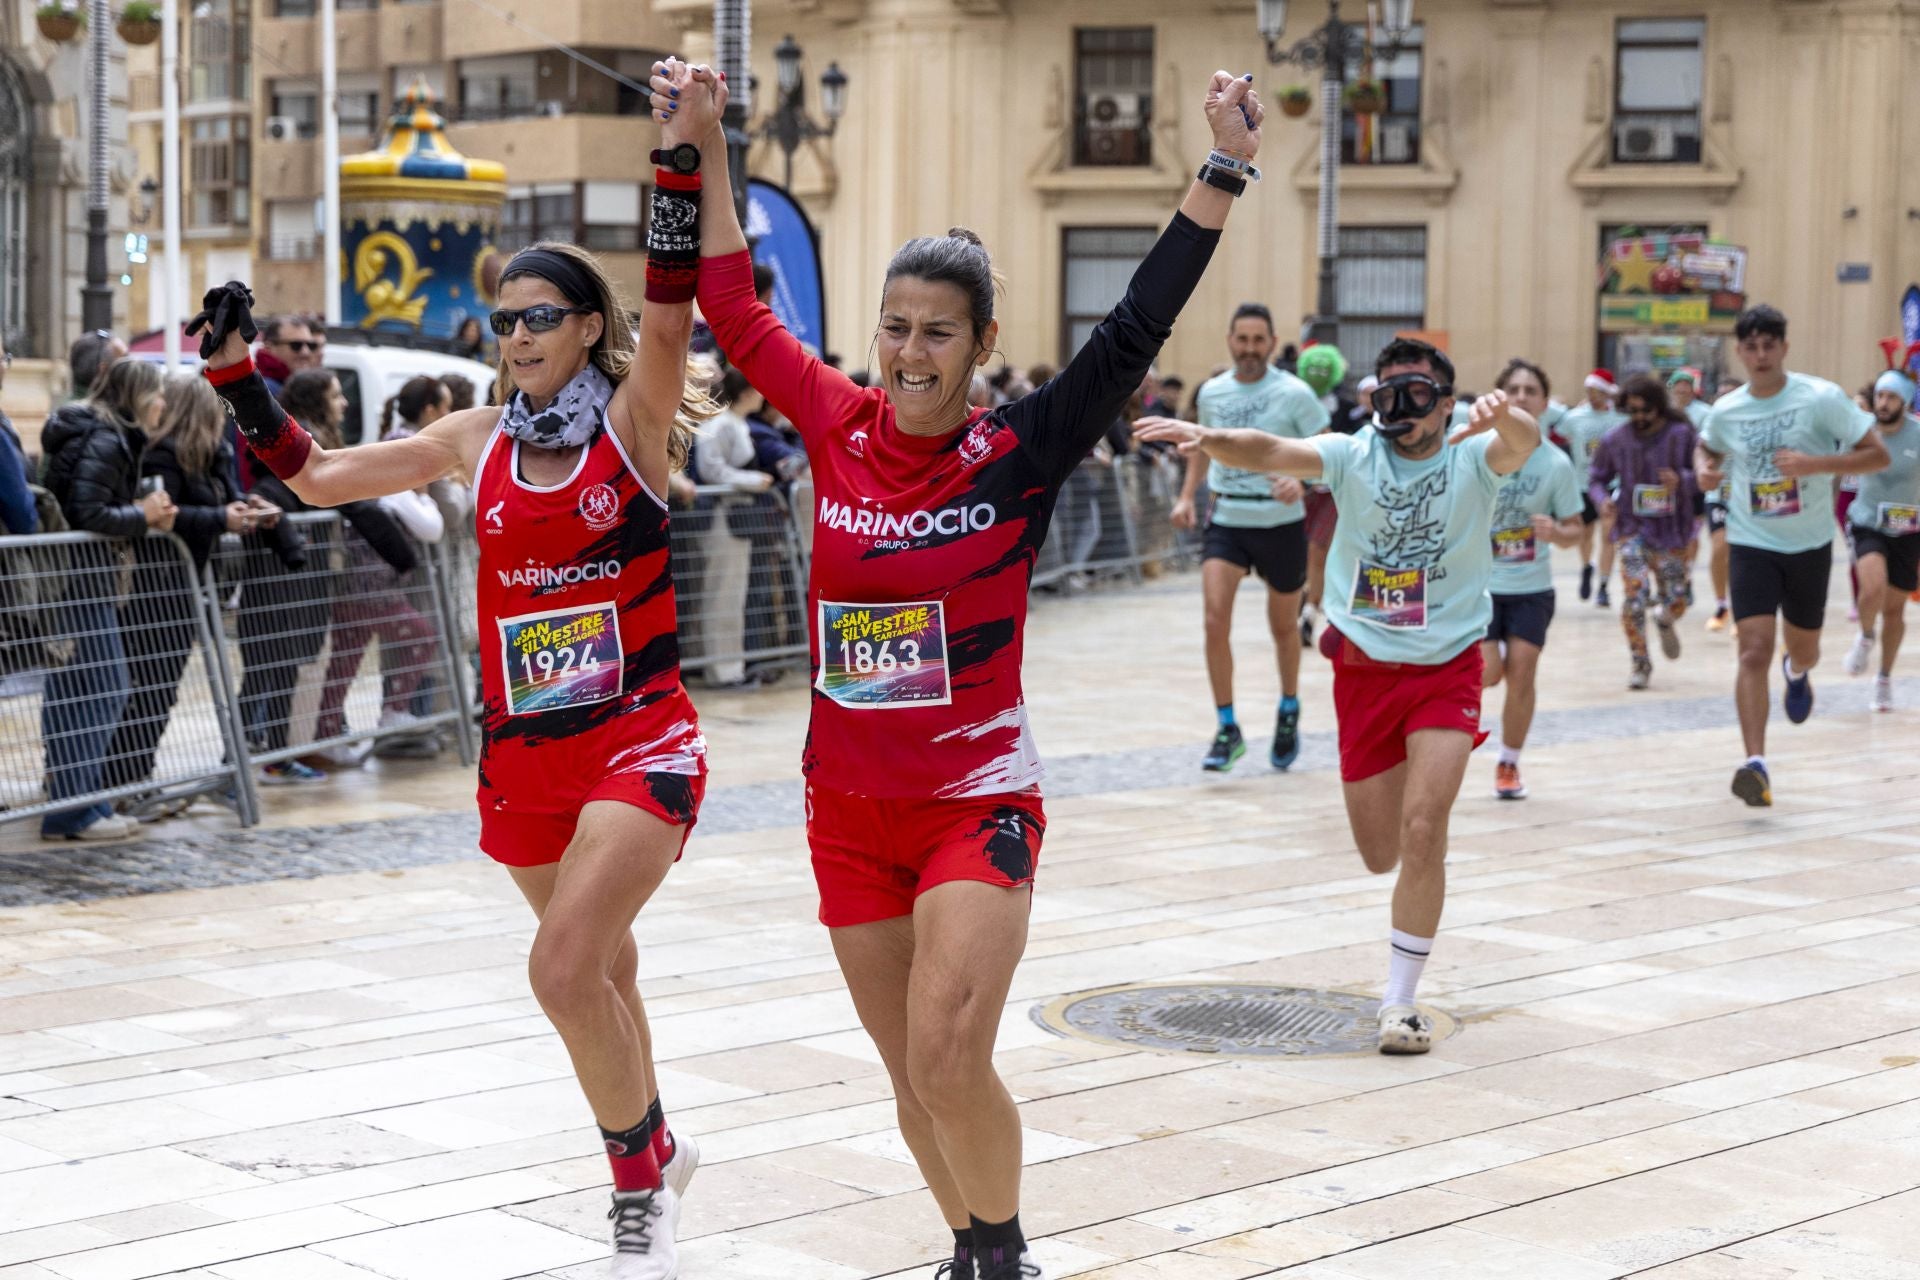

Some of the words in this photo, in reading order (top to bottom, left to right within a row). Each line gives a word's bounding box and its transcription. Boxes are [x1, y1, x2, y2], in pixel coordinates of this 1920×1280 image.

[1210, 153, 1235, 169] ALENCIA
[819, 496, 996, 537] MARINOCIO
[874, 540, 910, 550] GRUPO
[543, 586, 568, 595] GRUPO
[1372, 585, 1405, 609] 113
[841, 606, 928, 642] SILVESTRE
[842, 610, 871, 627] SAN
[521, 621, 550, 641] SAN
[522, 612, 603, 654] SILVESTRE
[555, 625, 605, 650] CARTAGENA
[874, 621, 930, 642] CARTAGENA
[521, 643, 600, 684] 1924
[840, 639, 921, 673] 1863
